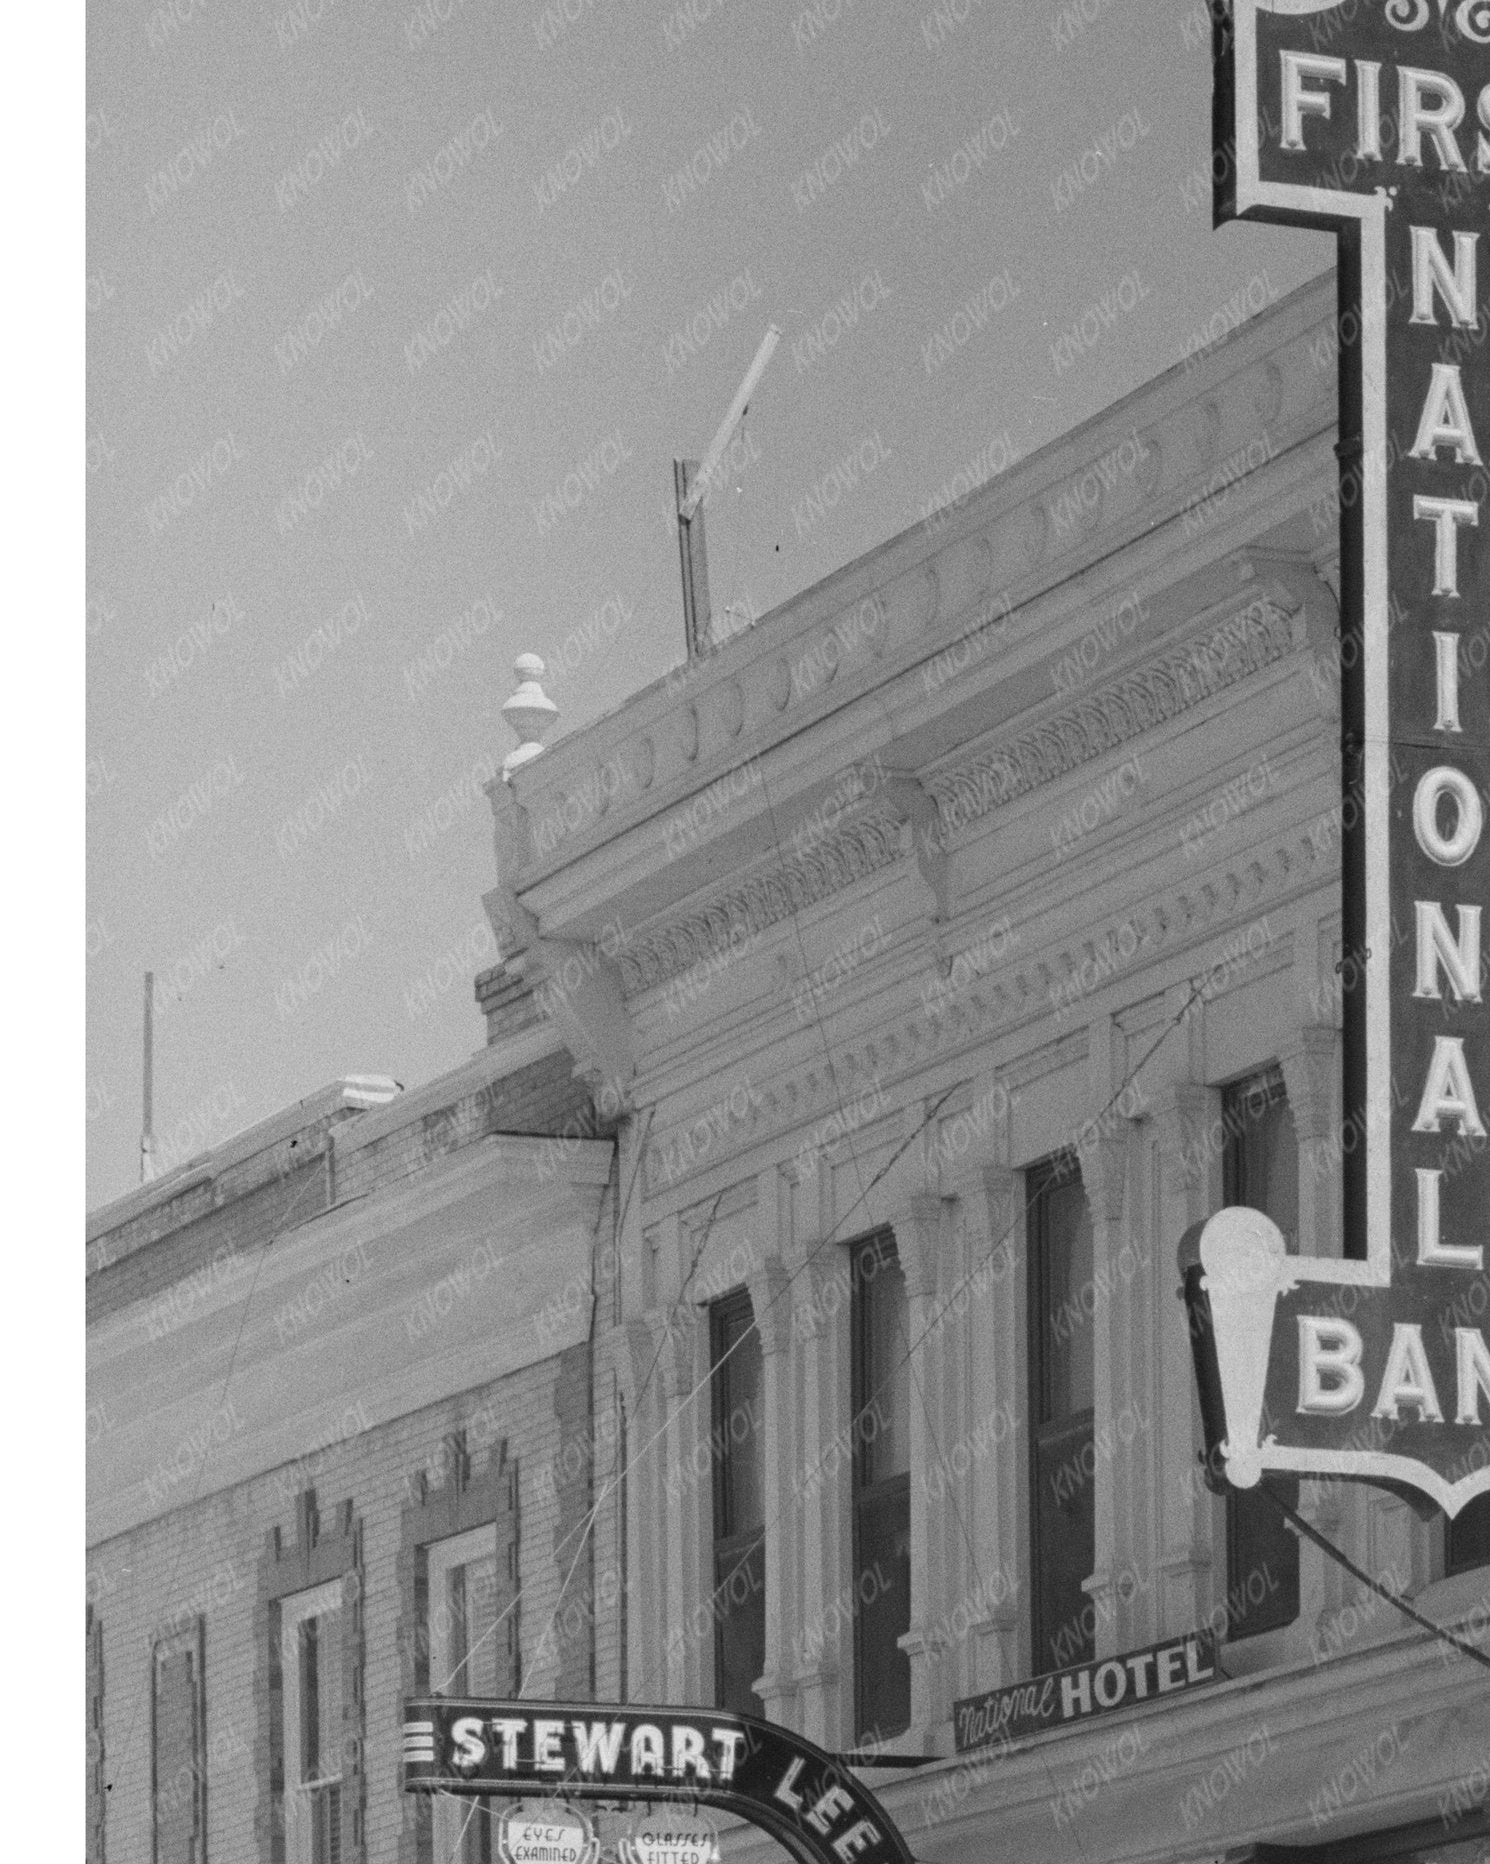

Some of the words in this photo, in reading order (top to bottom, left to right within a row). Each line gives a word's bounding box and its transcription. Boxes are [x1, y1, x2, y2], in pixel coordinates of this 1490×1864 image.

[1408, 226, 1487, 1270] NATIONAL
[959, 1677, 1054, 1747] National
[1061, 1640, 1214, 1719] HOTEL
[451, 1717, 745, 1780] STEWART
[514, 1845, 577, 1863] EXAMINED
[523, 1828, 566, 1842] EYES
[642, 1831, 711, 1848] GLASSES
